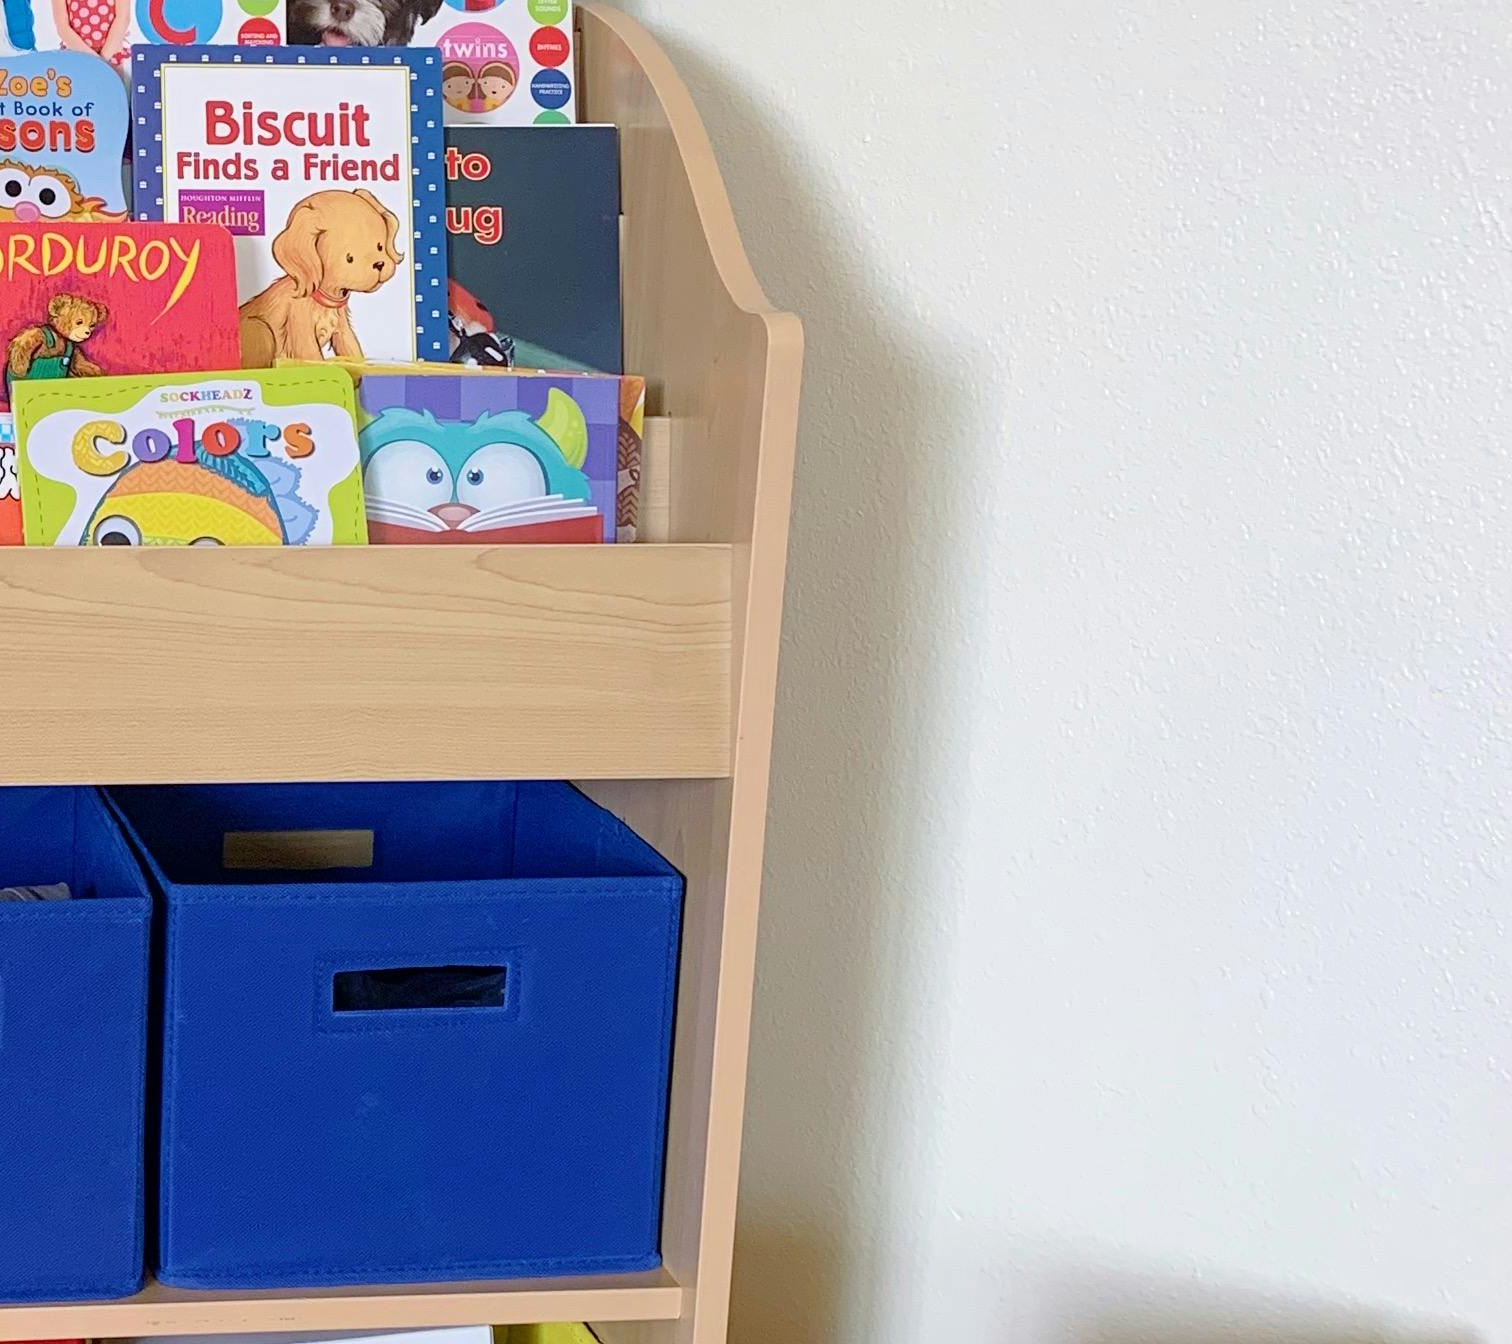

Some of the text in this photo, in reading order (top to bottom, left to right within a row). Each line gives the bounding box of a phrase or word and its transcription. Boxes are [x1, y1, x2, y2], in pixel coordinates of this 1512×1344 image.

[441, 37, 509, 60] twins
[14, 101, 63, 117] Book
[72, 102, 95, 117] of
[205, 100, 371, 146] Biscuit
[176, 152, 400, 182] Finds a Friend
[183, 205, 259, 233] Reading
[160, 389, 253, 403] SOCKHEADZ
[72, 418, 316, 476] Colors
